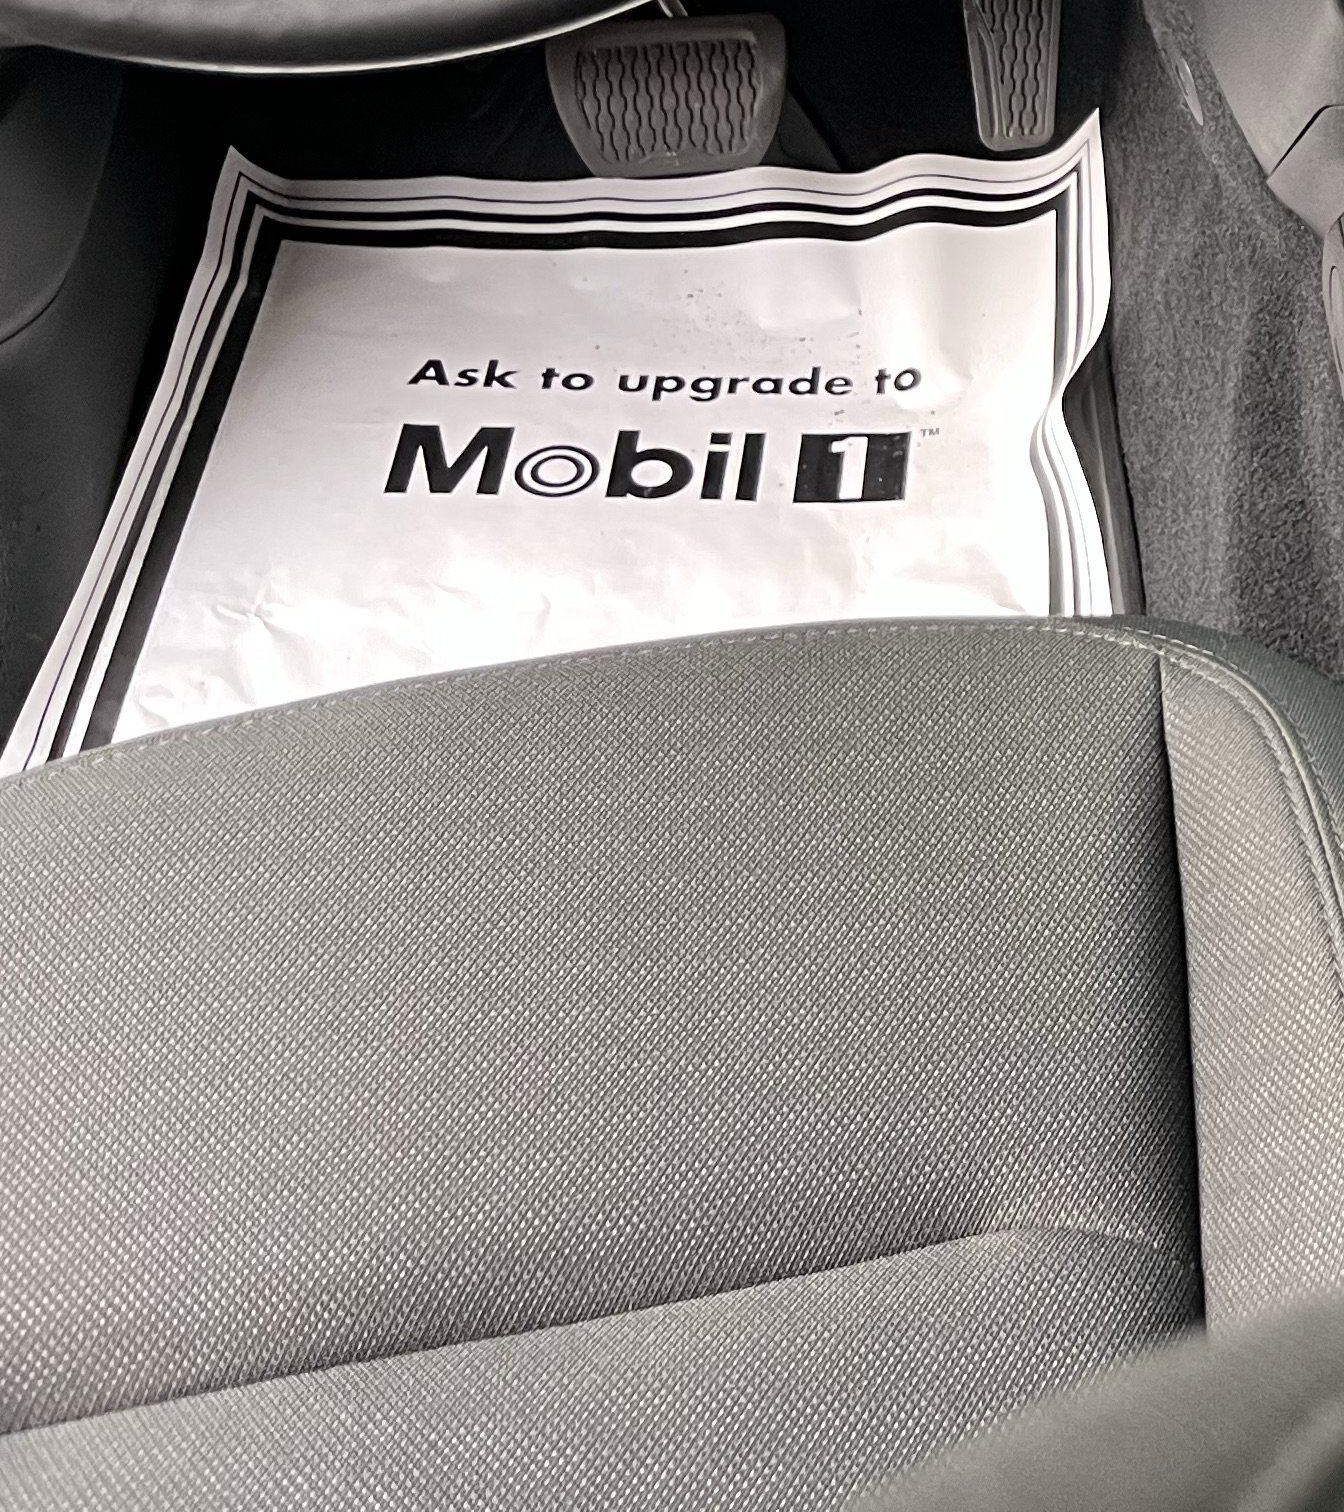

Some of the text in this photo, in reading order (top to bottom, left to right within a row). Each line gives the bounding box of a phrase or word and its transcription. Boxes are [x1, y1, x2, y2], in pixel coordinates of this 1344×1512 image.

[407, 359, 923, 402] Ask to upgrade to
[386, 423, 766, 500] Mobil
